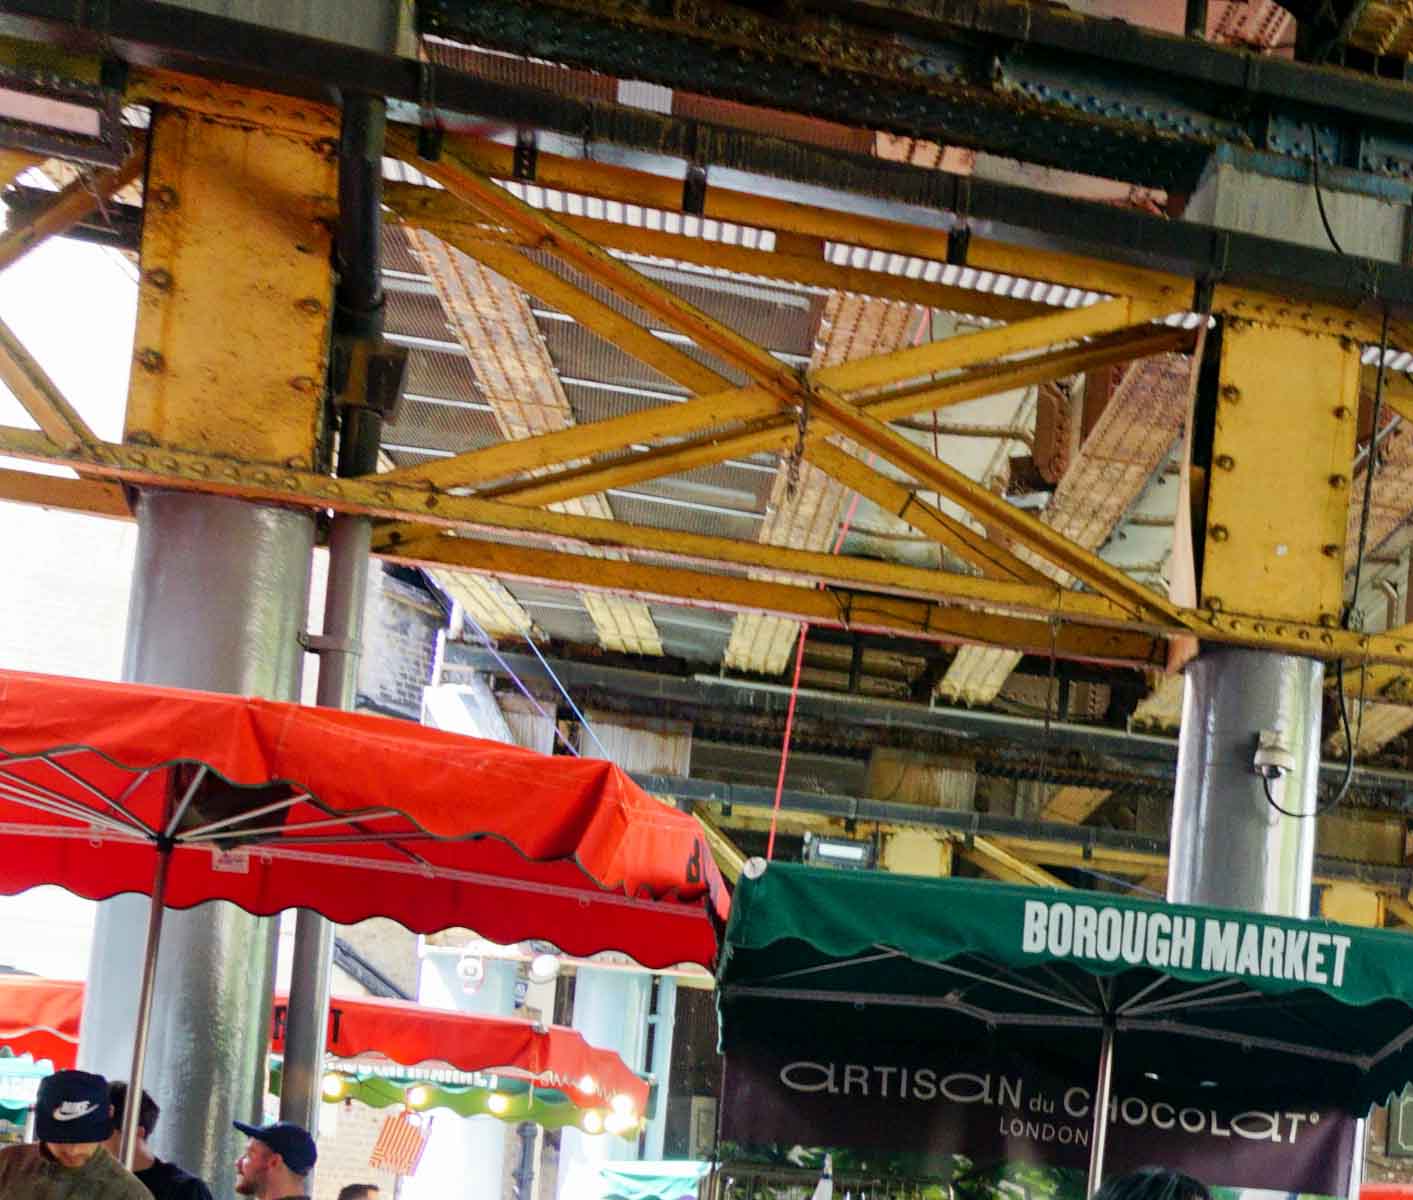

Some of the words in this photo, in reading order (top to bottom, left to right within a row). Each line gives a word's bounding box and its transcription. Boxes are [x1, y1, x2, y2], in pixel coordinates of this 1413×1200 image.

[1022, 899, 1196, 969] BOROUGH
[1200, 919, 1351, 987] MARKET
[1028, 1093, 1055, 1113] du
[999, 1116, 1089, 1147] LONDON
